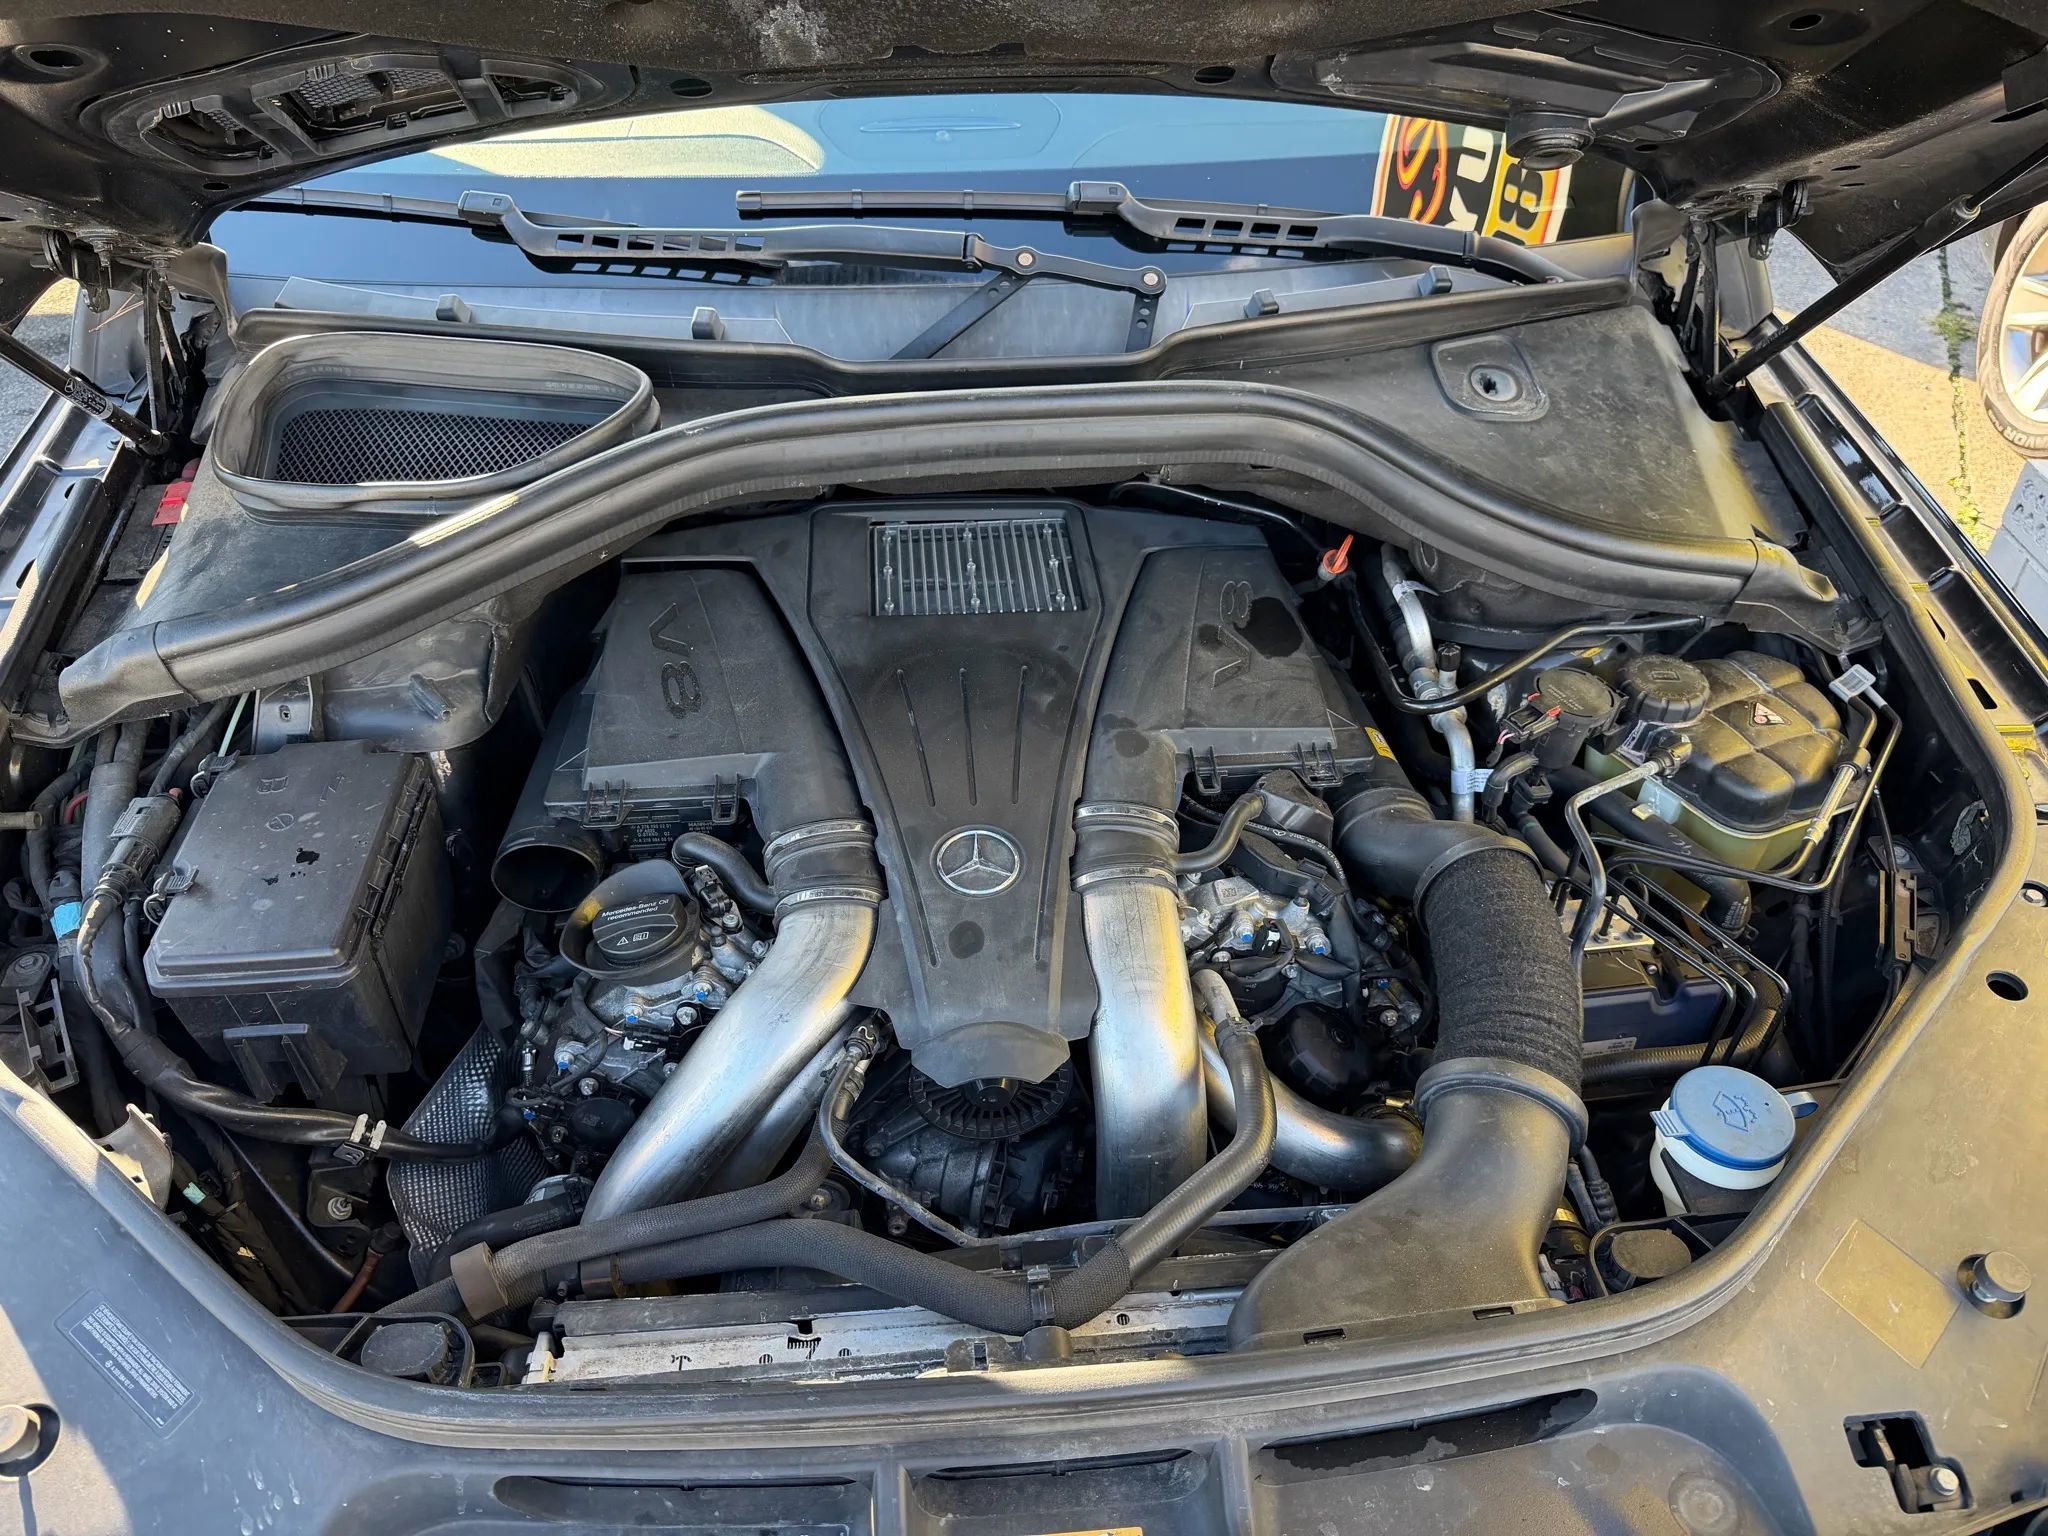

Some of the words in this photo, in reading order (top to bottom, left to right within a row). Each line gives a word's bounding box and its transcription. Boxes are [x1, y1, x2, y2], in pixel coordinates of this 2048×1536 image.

[648, 602, 702, 719] V8
[601, 901, 657, 918] Mercedes-Benz
[607, 905, 659, 922] recommended
